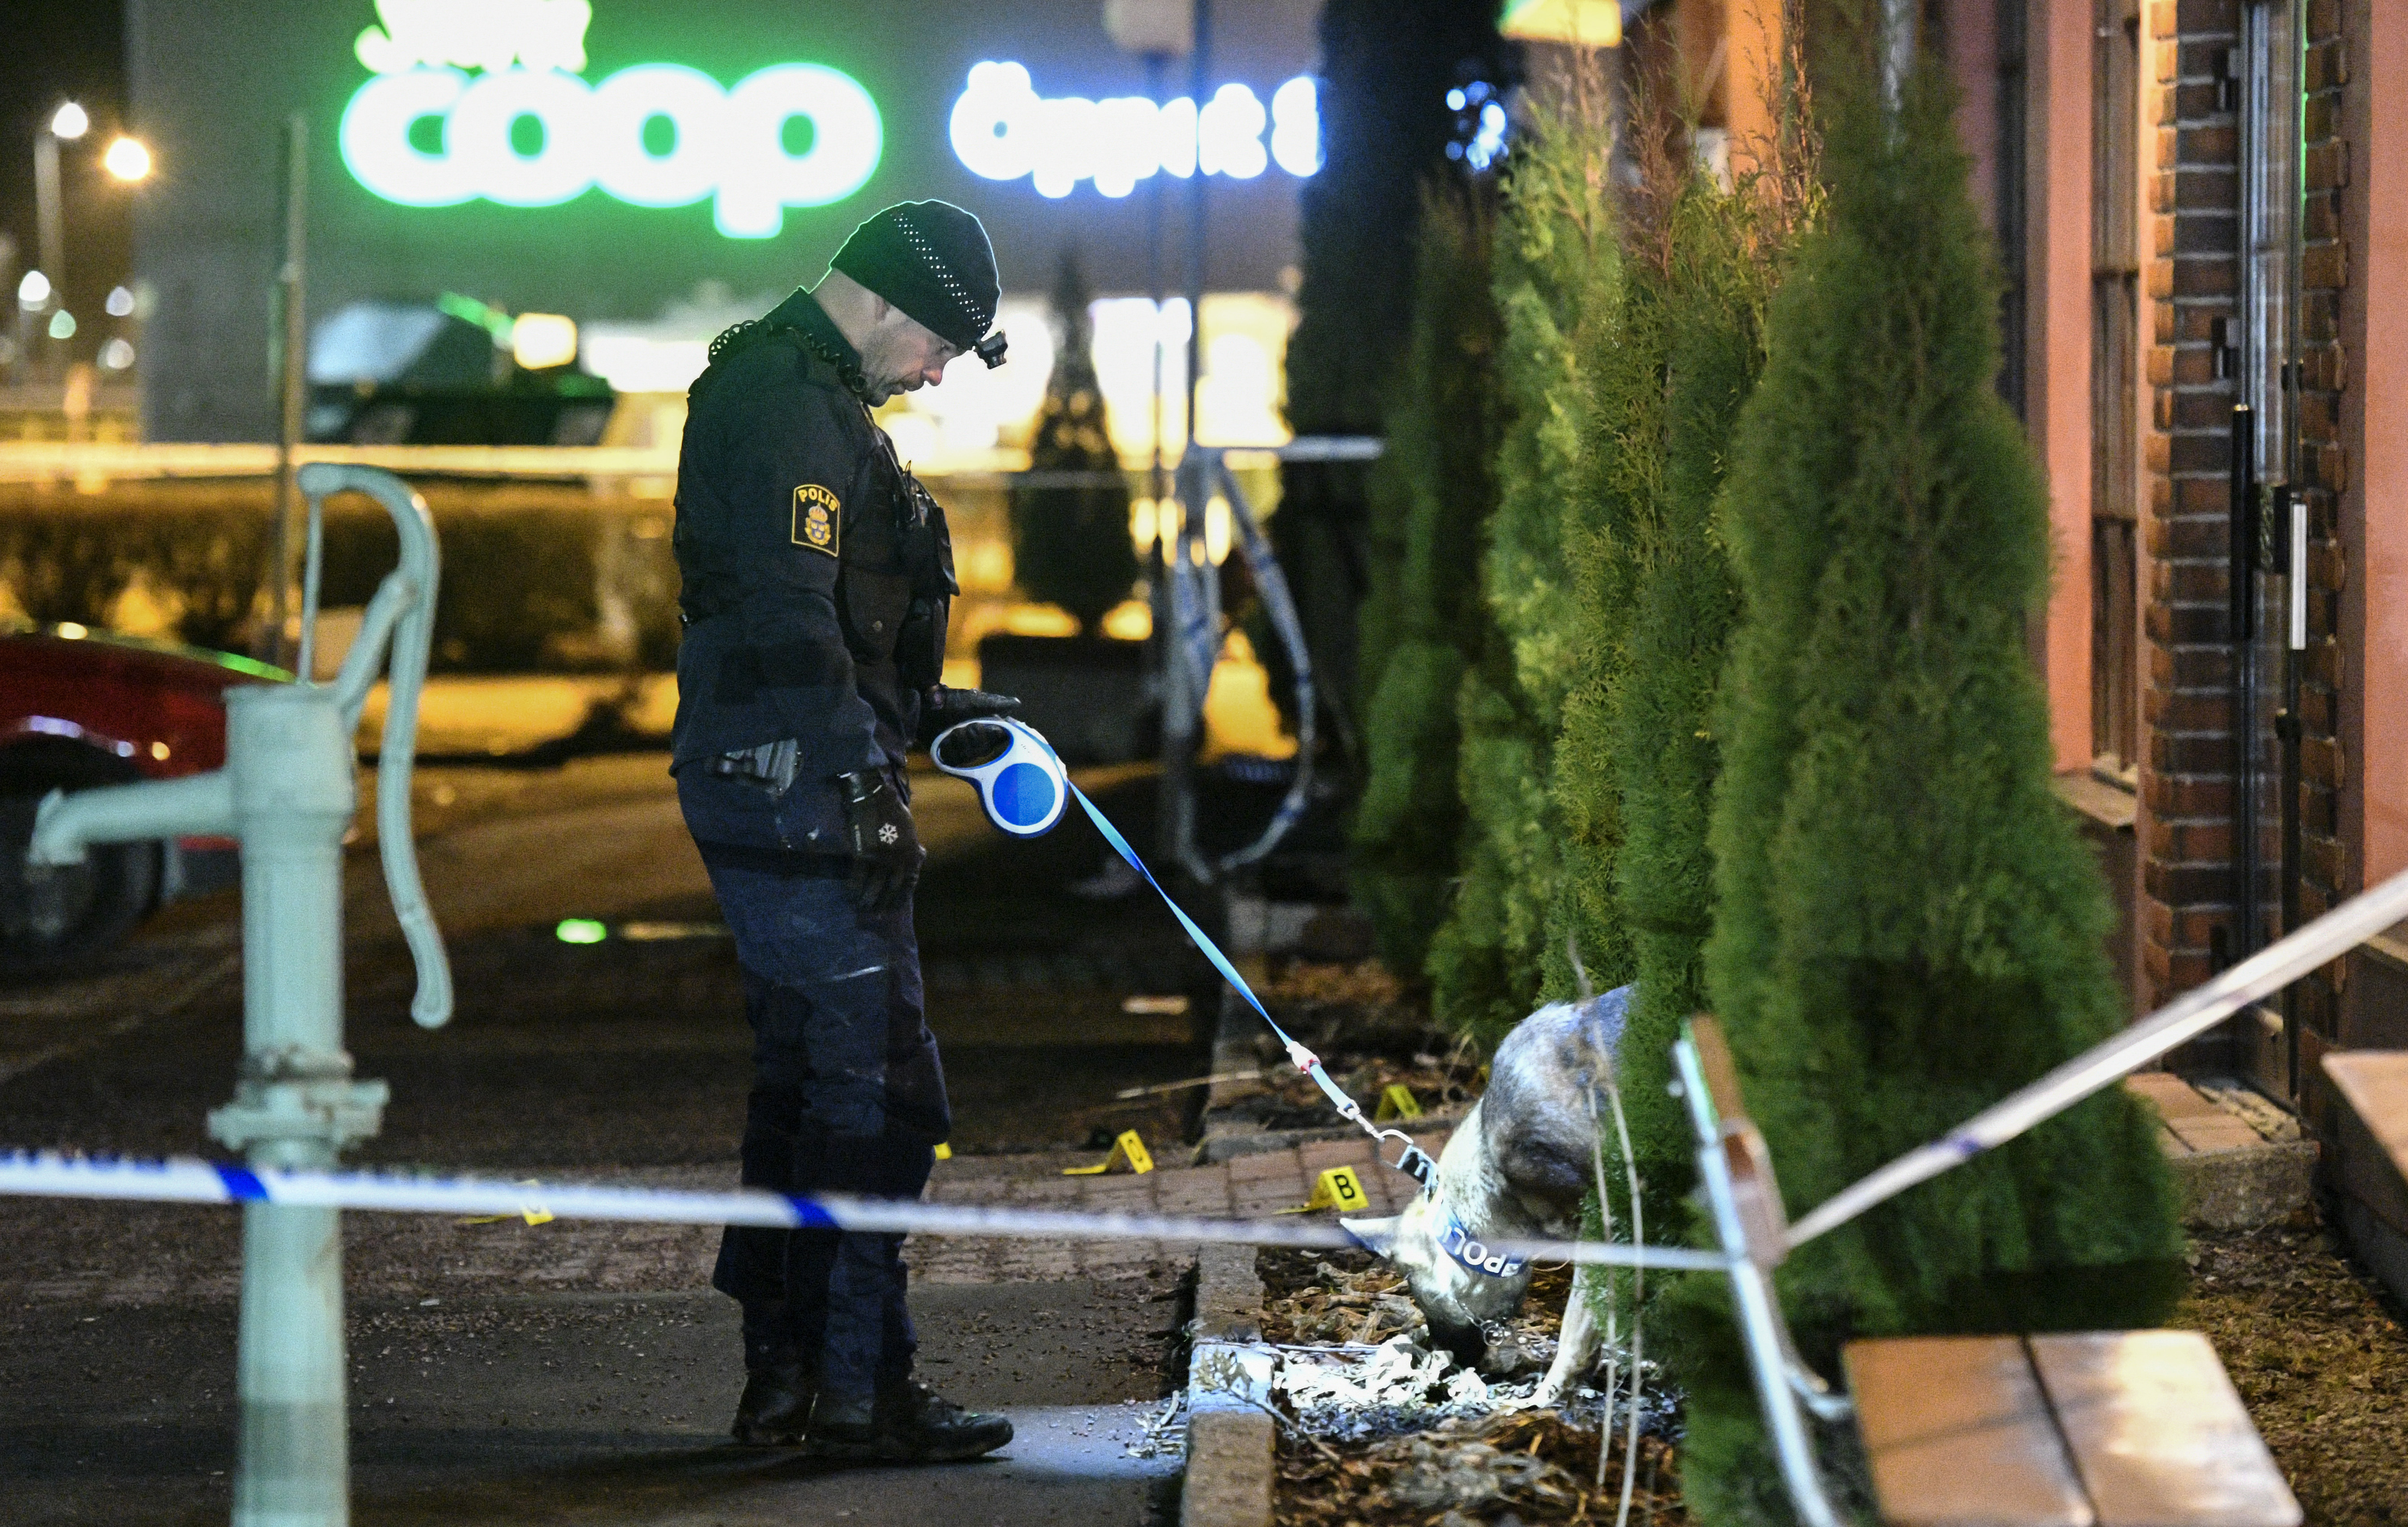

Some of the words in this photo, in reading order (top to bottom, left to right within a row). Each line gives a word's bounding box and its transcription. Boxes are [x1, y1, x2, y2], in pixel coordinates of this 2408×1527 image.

[339, 63, 883, 239] coop
[798, 488, 837, 512] POLIS
[1334, 1175, 1355, 1199] B
